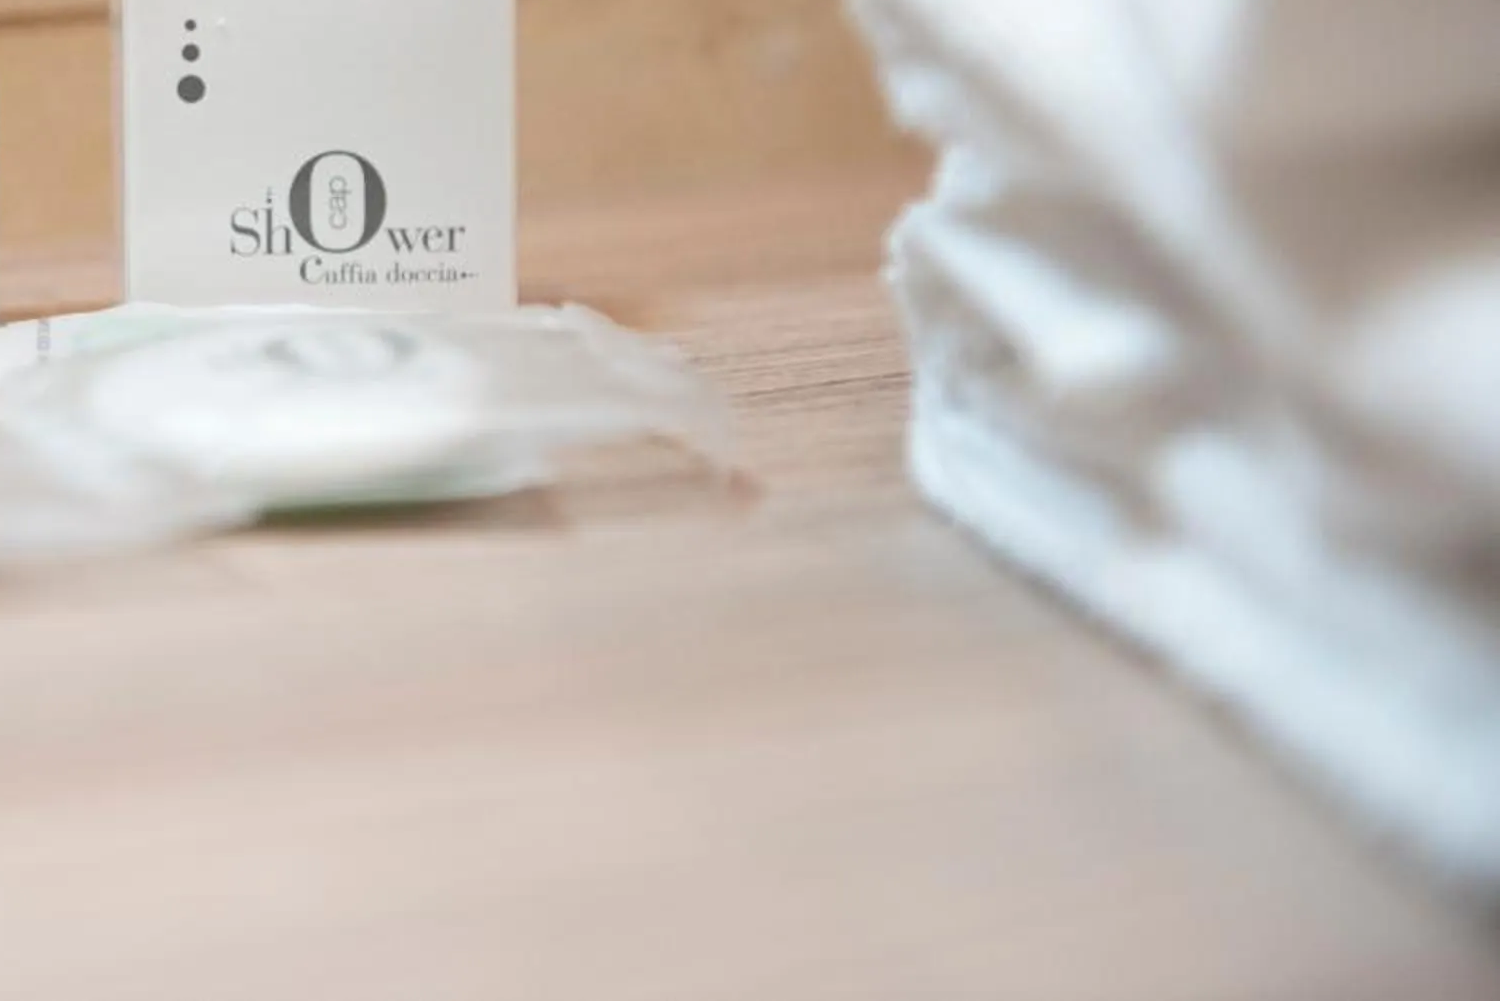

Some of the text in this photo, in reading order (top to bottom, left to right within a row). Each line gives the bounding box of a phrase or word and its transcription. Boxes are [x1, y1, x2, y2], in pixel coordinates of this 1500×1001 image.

[328, 175, 352, 230] cap
[299, 256, 458, 286] Cuffia doccia
